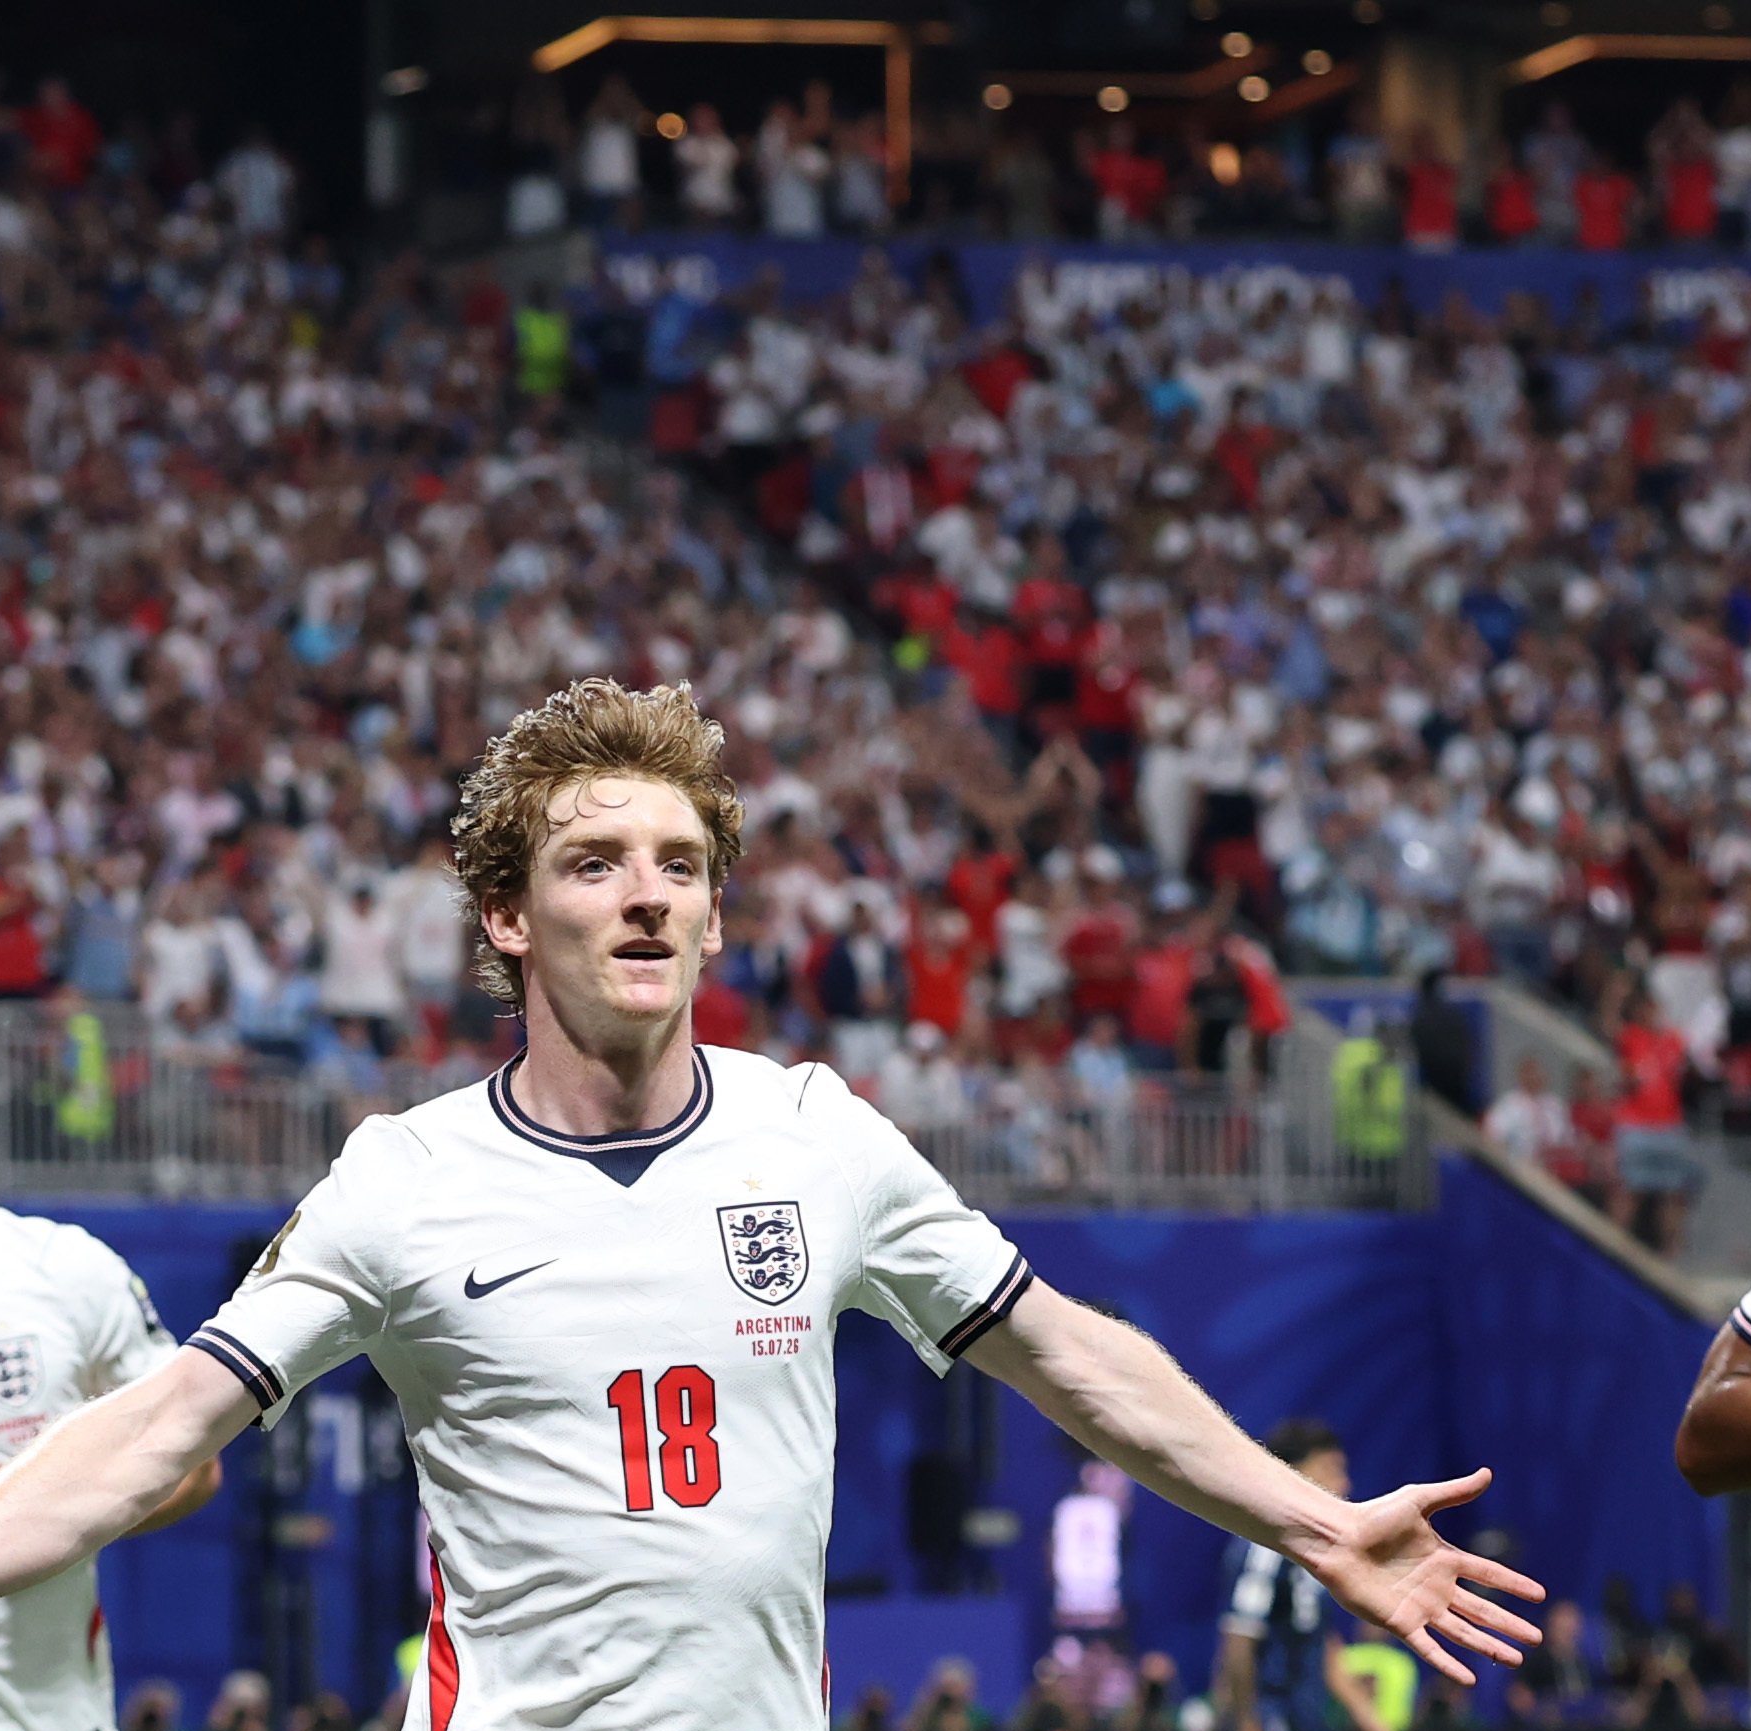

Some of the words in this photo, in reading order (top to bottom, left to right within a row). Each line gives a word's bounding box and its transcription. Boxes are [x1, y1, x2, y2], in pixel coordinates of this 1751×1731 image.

[735, 1315, 812, 1336] ARGENTINA
[752, 1338, 799, 1356] 15.07.26
[607, 1364, 721, 1512] 18
